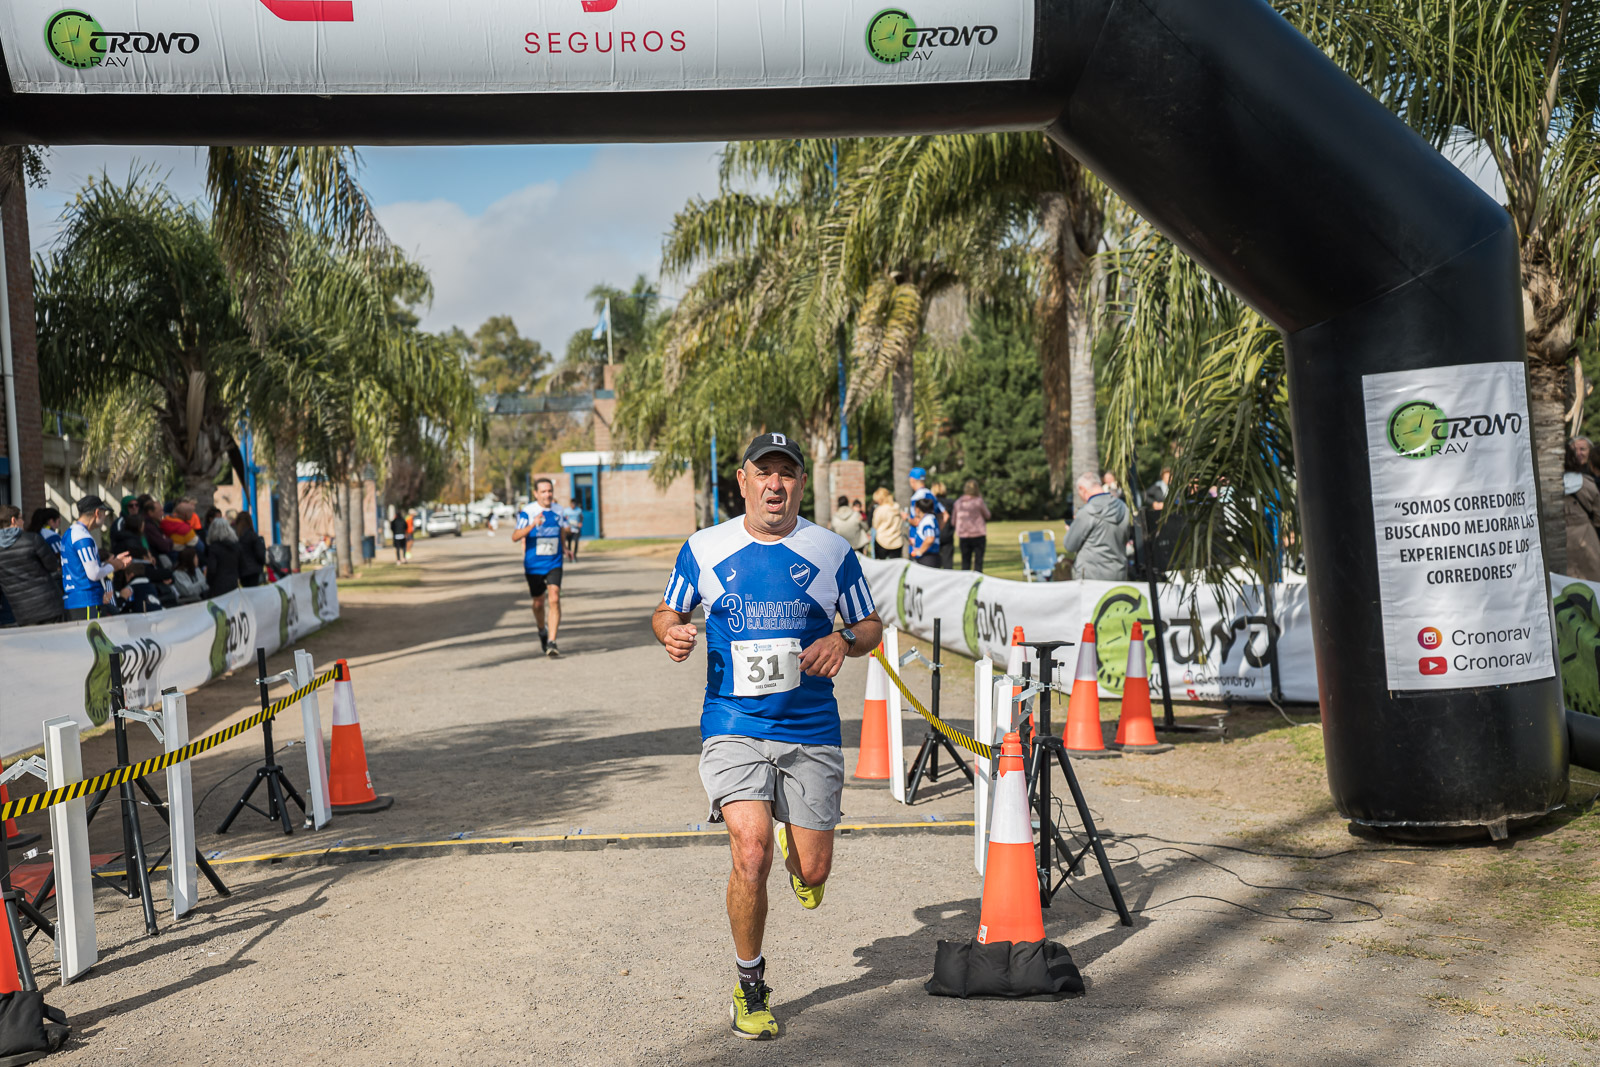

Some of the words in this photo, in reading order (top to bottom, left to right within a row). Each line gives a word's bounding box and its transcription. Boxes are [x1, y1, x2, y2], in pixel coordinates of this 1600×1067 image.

[89, 31, 200, 54] CRONO
[524, 30, 686, 54] SEGUROS
[902, 25, 998, 48] CRONO
[89, 56, 129, 68] RAV
[899, 50, 934, 61] RAV
[1431, 412, 1522, 441] CRONO
[771, 432, 787, 446] D
[1430, 441, 1469, 456] RAV
[1453, 491, 1526, 512] CORREDORES
[1384, 521, 1461, 541] BUSCANDO
[1464, 516, 1521, 535] MEJORAR
[1521, 514, 1535, 530] LAS
[1399, 542, 1496, 563] EXPERIENCIAS
[1498, 540, 1513, 555] DE
[1515, 538, 1530, 554] LOS
[721, 593, 745, 633] 3
[744, 598, 811, 618] MARATÓN
[1451, 627, 1531, 646] Cronorav
[746, 654, 785, 683] 31
[1453, 652, 1533, 671] Cronorav
